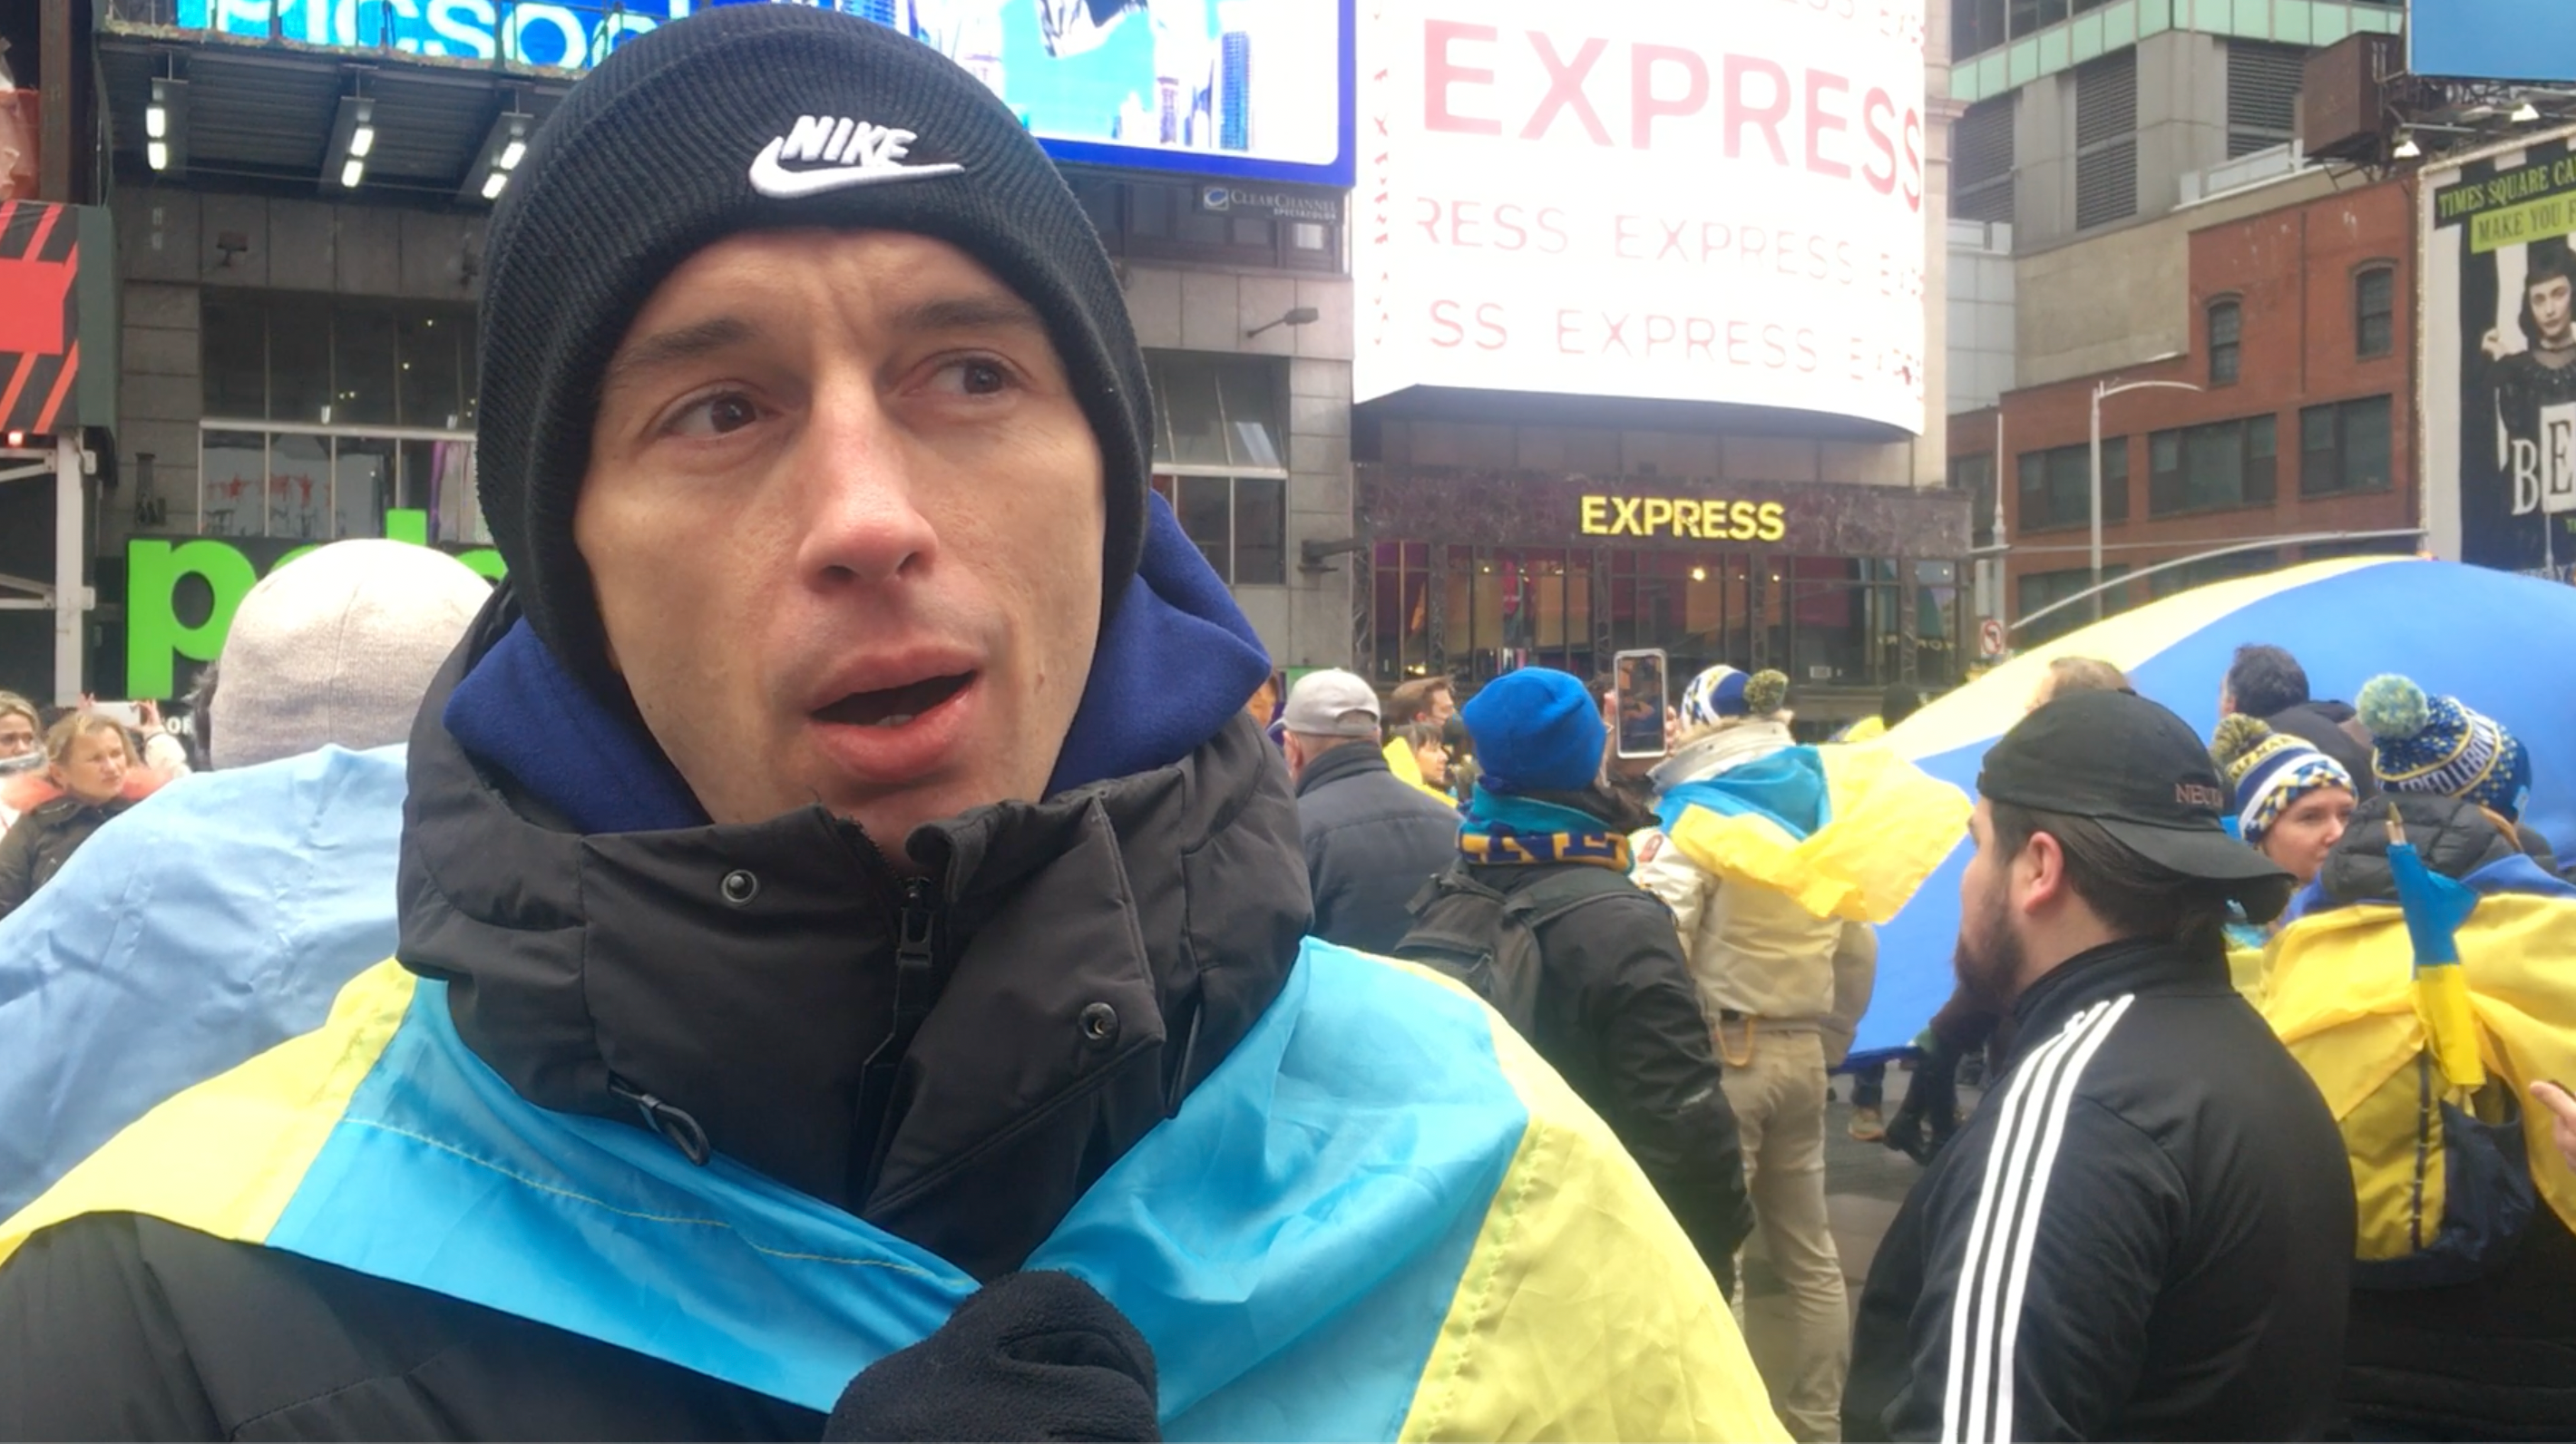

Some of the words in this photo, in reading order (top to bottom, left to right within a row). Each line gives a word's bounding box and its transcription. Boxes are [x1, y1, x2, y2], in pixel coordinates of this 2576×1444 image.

[781, 114, 918, 166] NIKE
[1424, 18, 1922, 214] EXPRESS
[2439, 186, 2484, 218] TIMES
[2488, 167, 2549, 205] SQUARE
[2553, 156, 2576, 187] CA
[1615, 214, 1853, 286] EXPRESS
[2478, 211, 2524, 243] MAKE
[2530, 202, 2561, 232] YOU
[1429, 298, 1508, 351] SS
[1556, 308, 1818, 373] EXPRESS
[1582, 495, 1785, 542] EXPRESS
